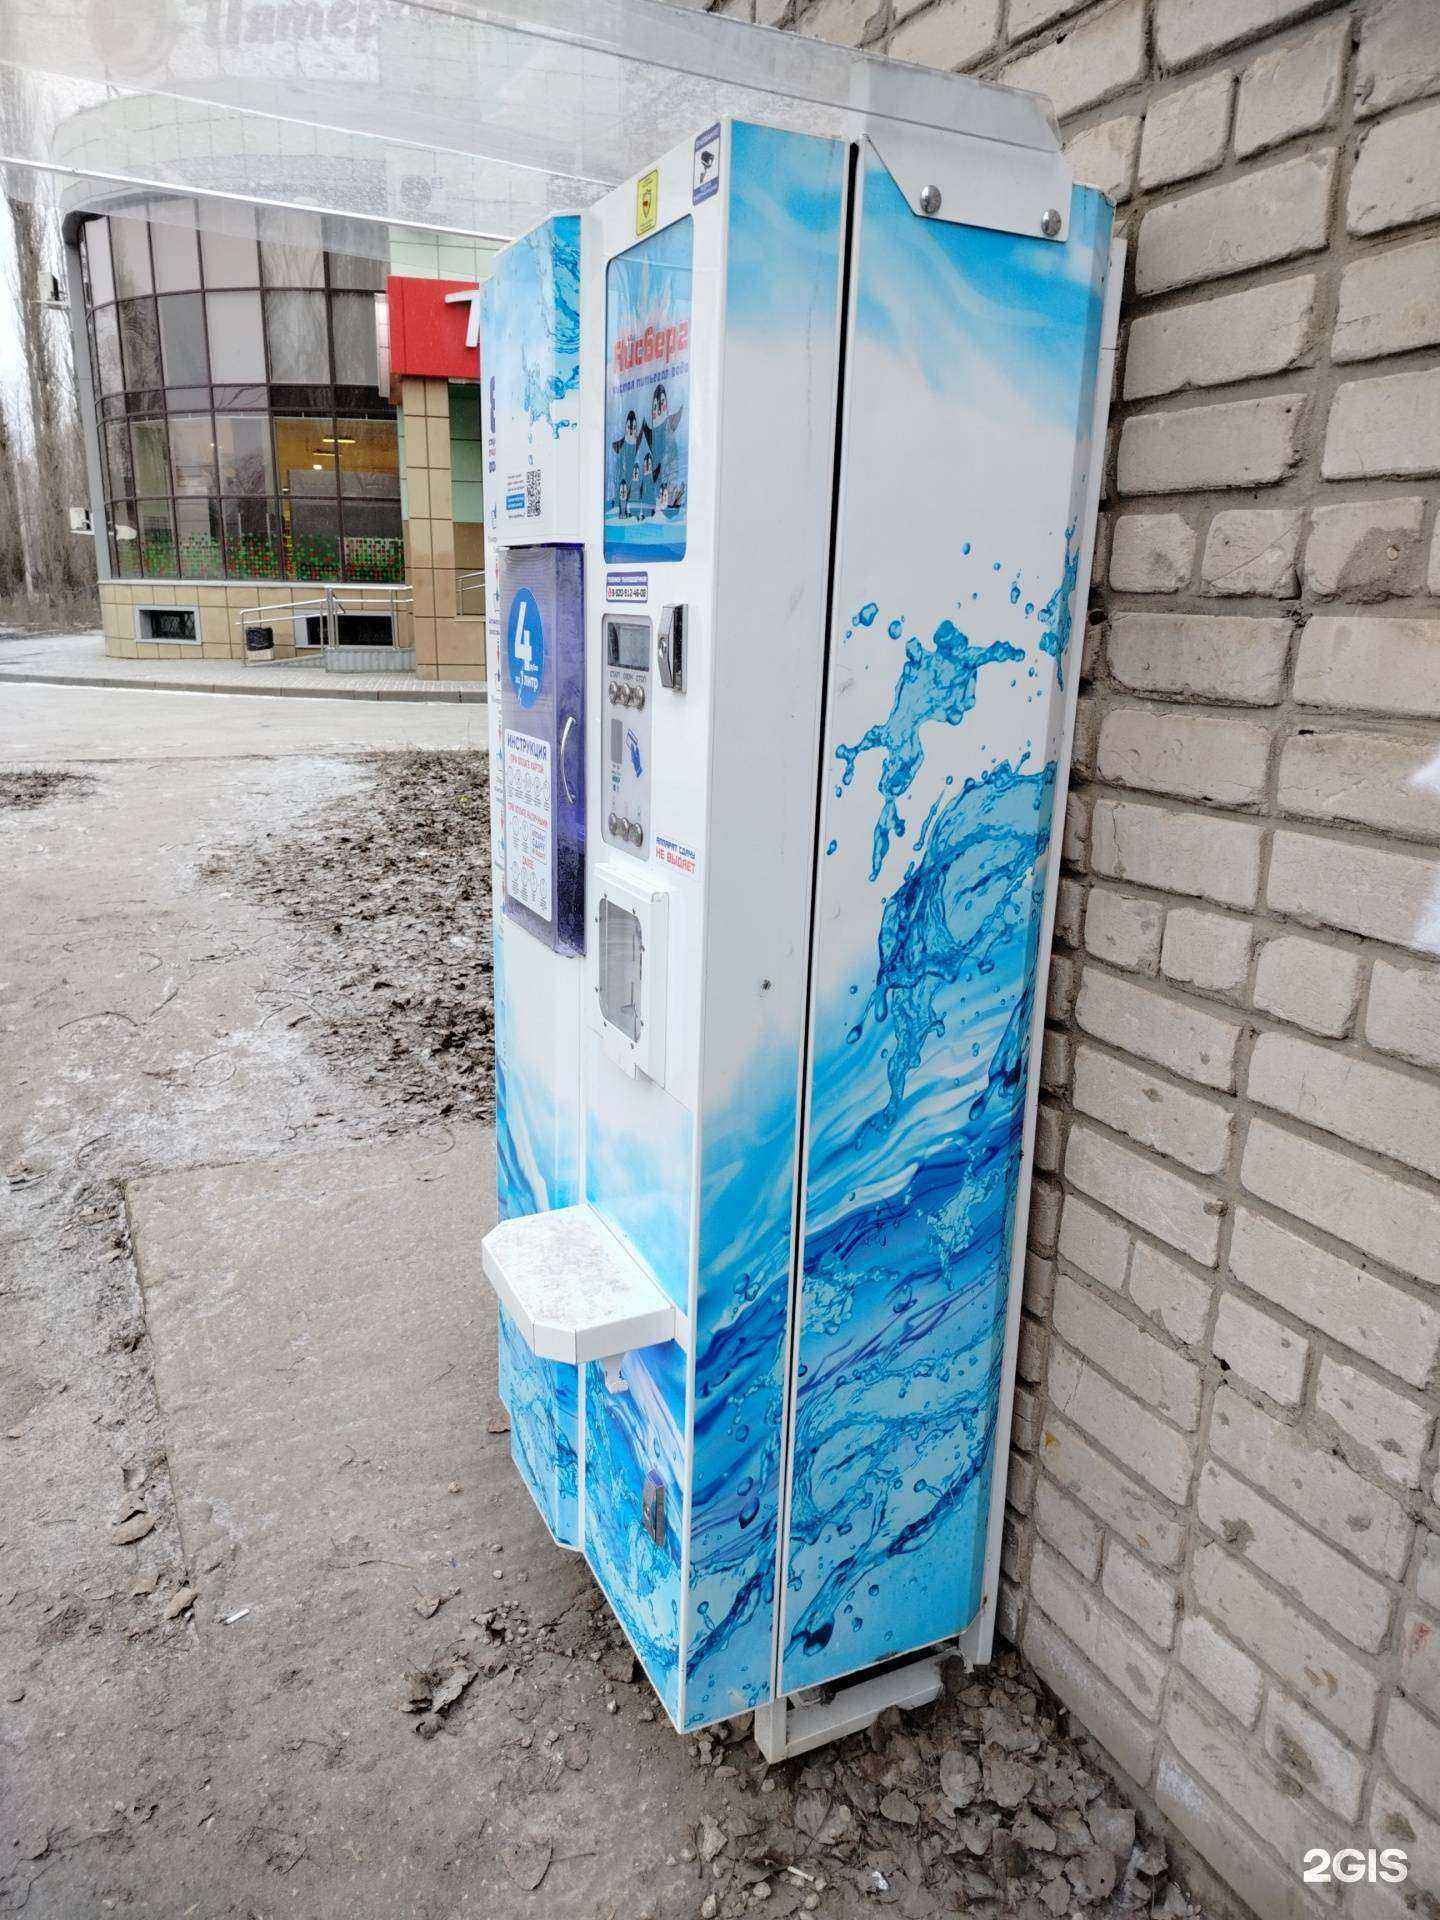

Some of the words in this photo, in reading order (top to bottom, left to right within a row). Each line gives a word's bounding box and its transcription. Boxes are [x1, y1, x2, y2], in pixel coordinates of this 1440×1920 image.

[507, 732, 547, 760] ИНСТРУКЦИЯ
[656, 846, 665, 860] НЕ
[667, 851, 696, 874] ВЫДАЕТ
